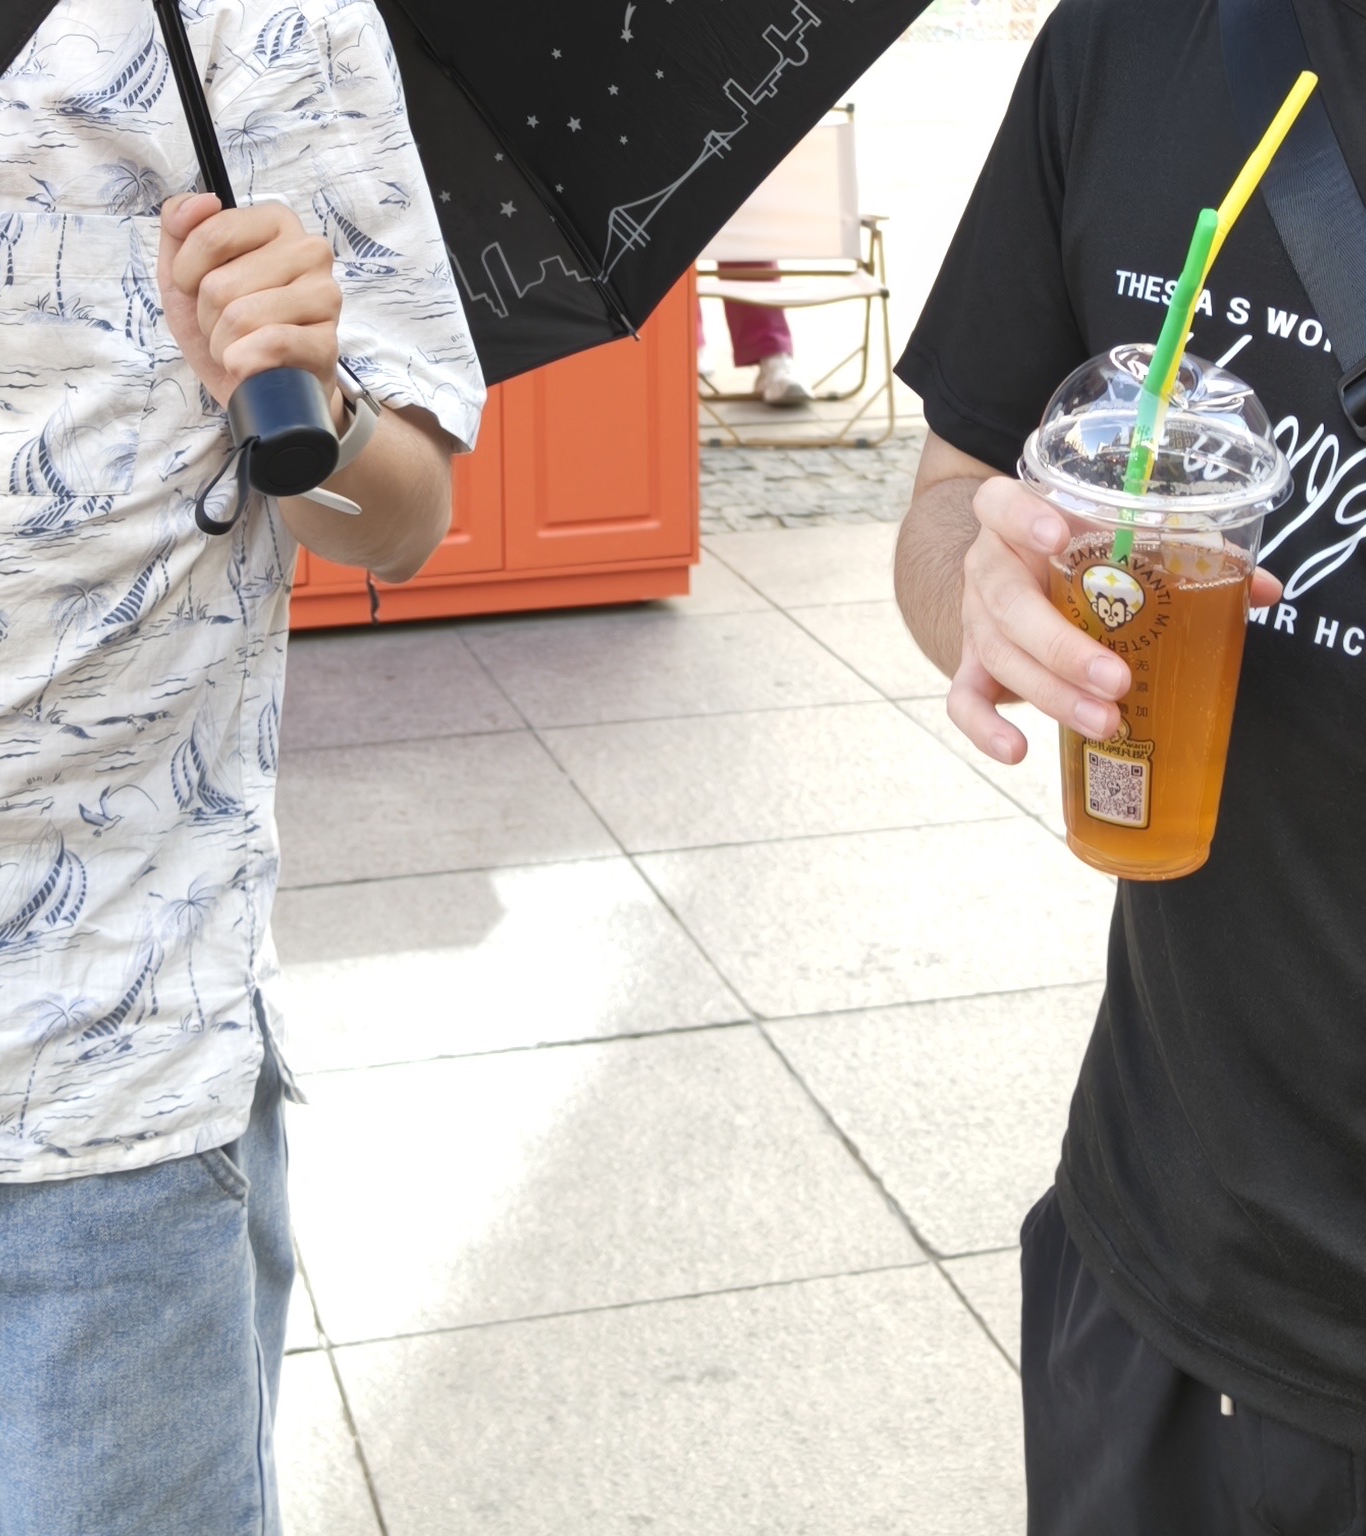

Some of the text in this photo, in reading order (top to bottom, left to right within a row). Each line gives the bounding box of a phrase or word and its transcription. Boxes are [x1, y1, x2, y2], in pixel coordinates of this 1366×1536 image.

[1226, 297, 1251, 325] S
[1267, 306, 1333, 353] WO
[1117, 554, 1172, 605] AVANTI
